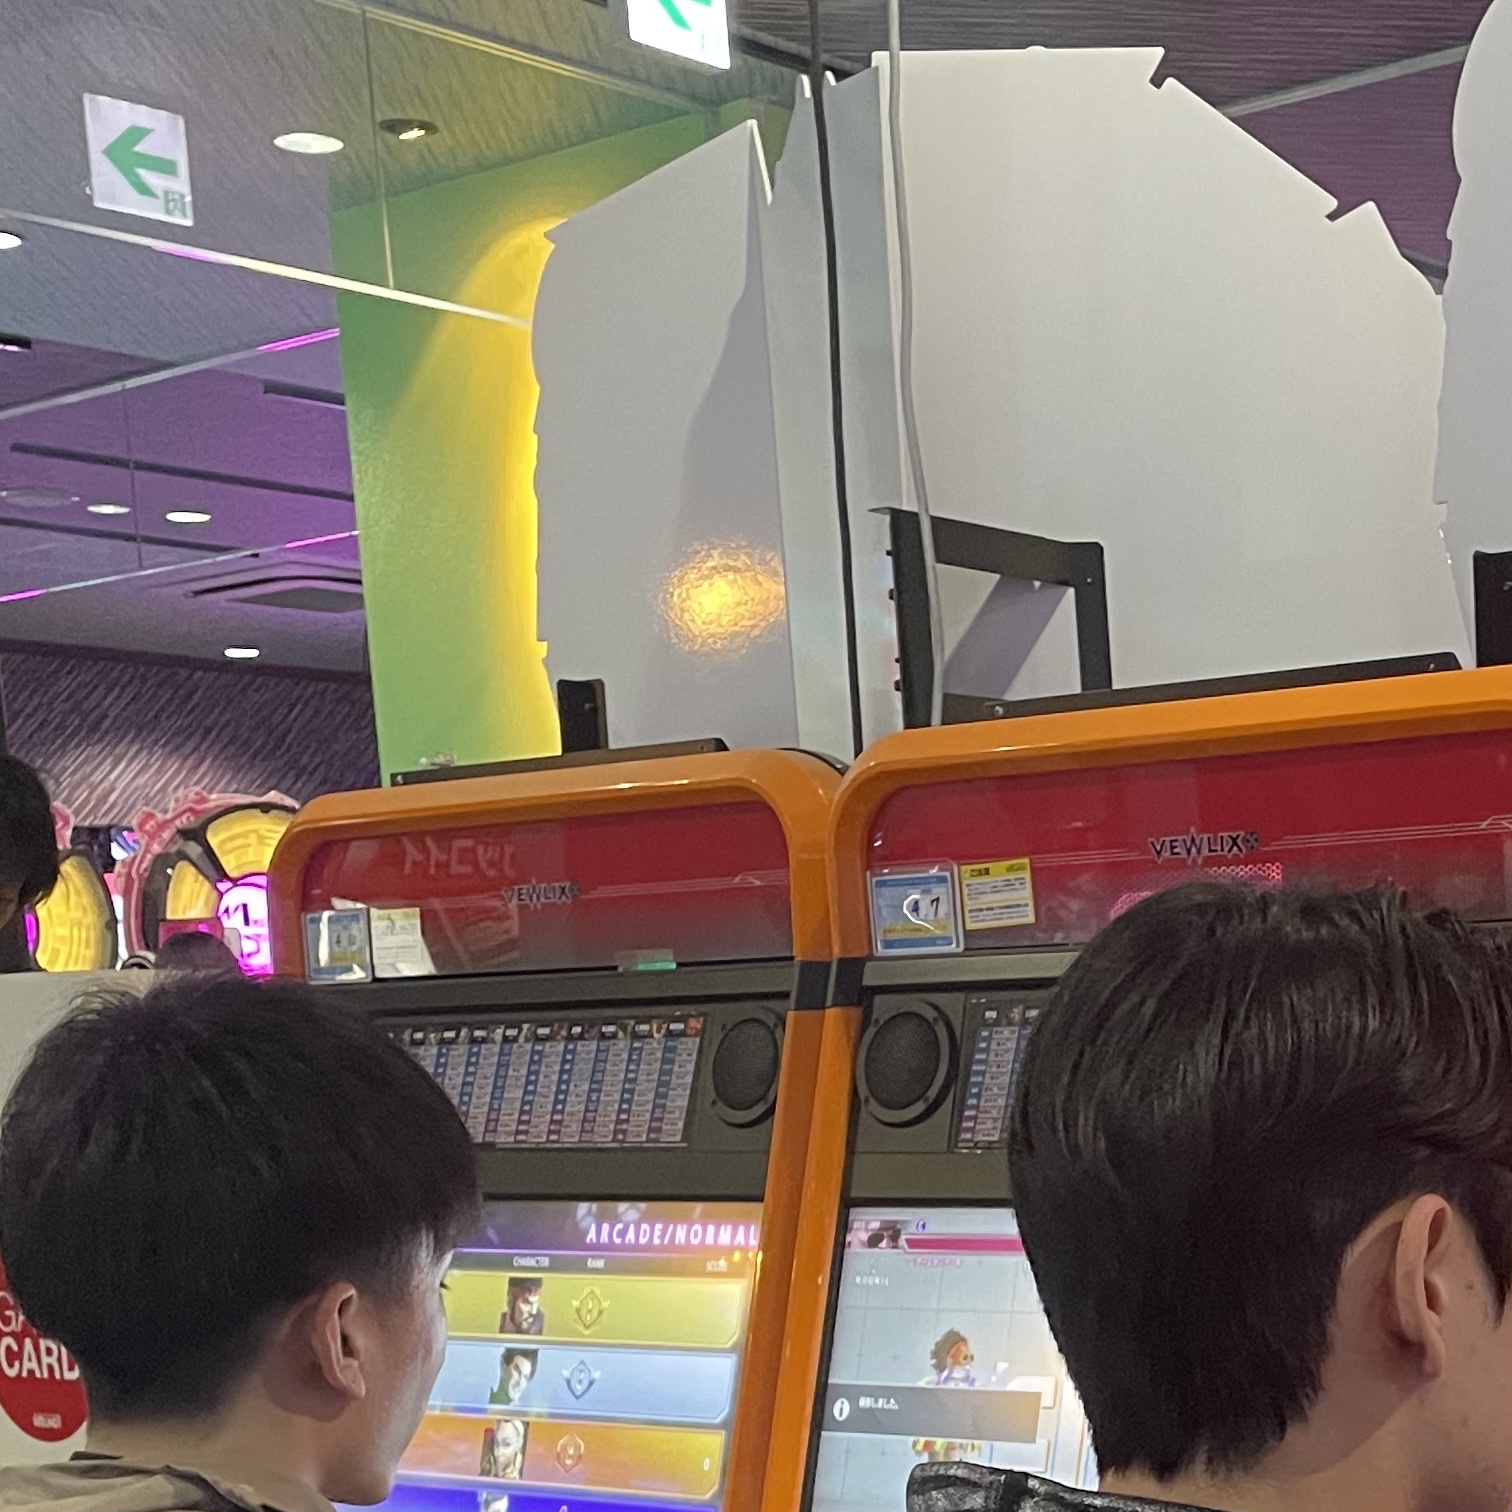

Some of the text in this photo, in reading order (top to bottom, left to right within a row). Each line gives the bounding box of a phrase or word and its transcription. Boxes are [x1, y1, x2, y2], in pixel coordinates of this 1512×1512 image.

[1148, 827, 1244, 864] VEWLIX
[503, 880, 573, 909] VEWLIX
[585, 1222, 759, 1247] ARCADE/NORMAL
